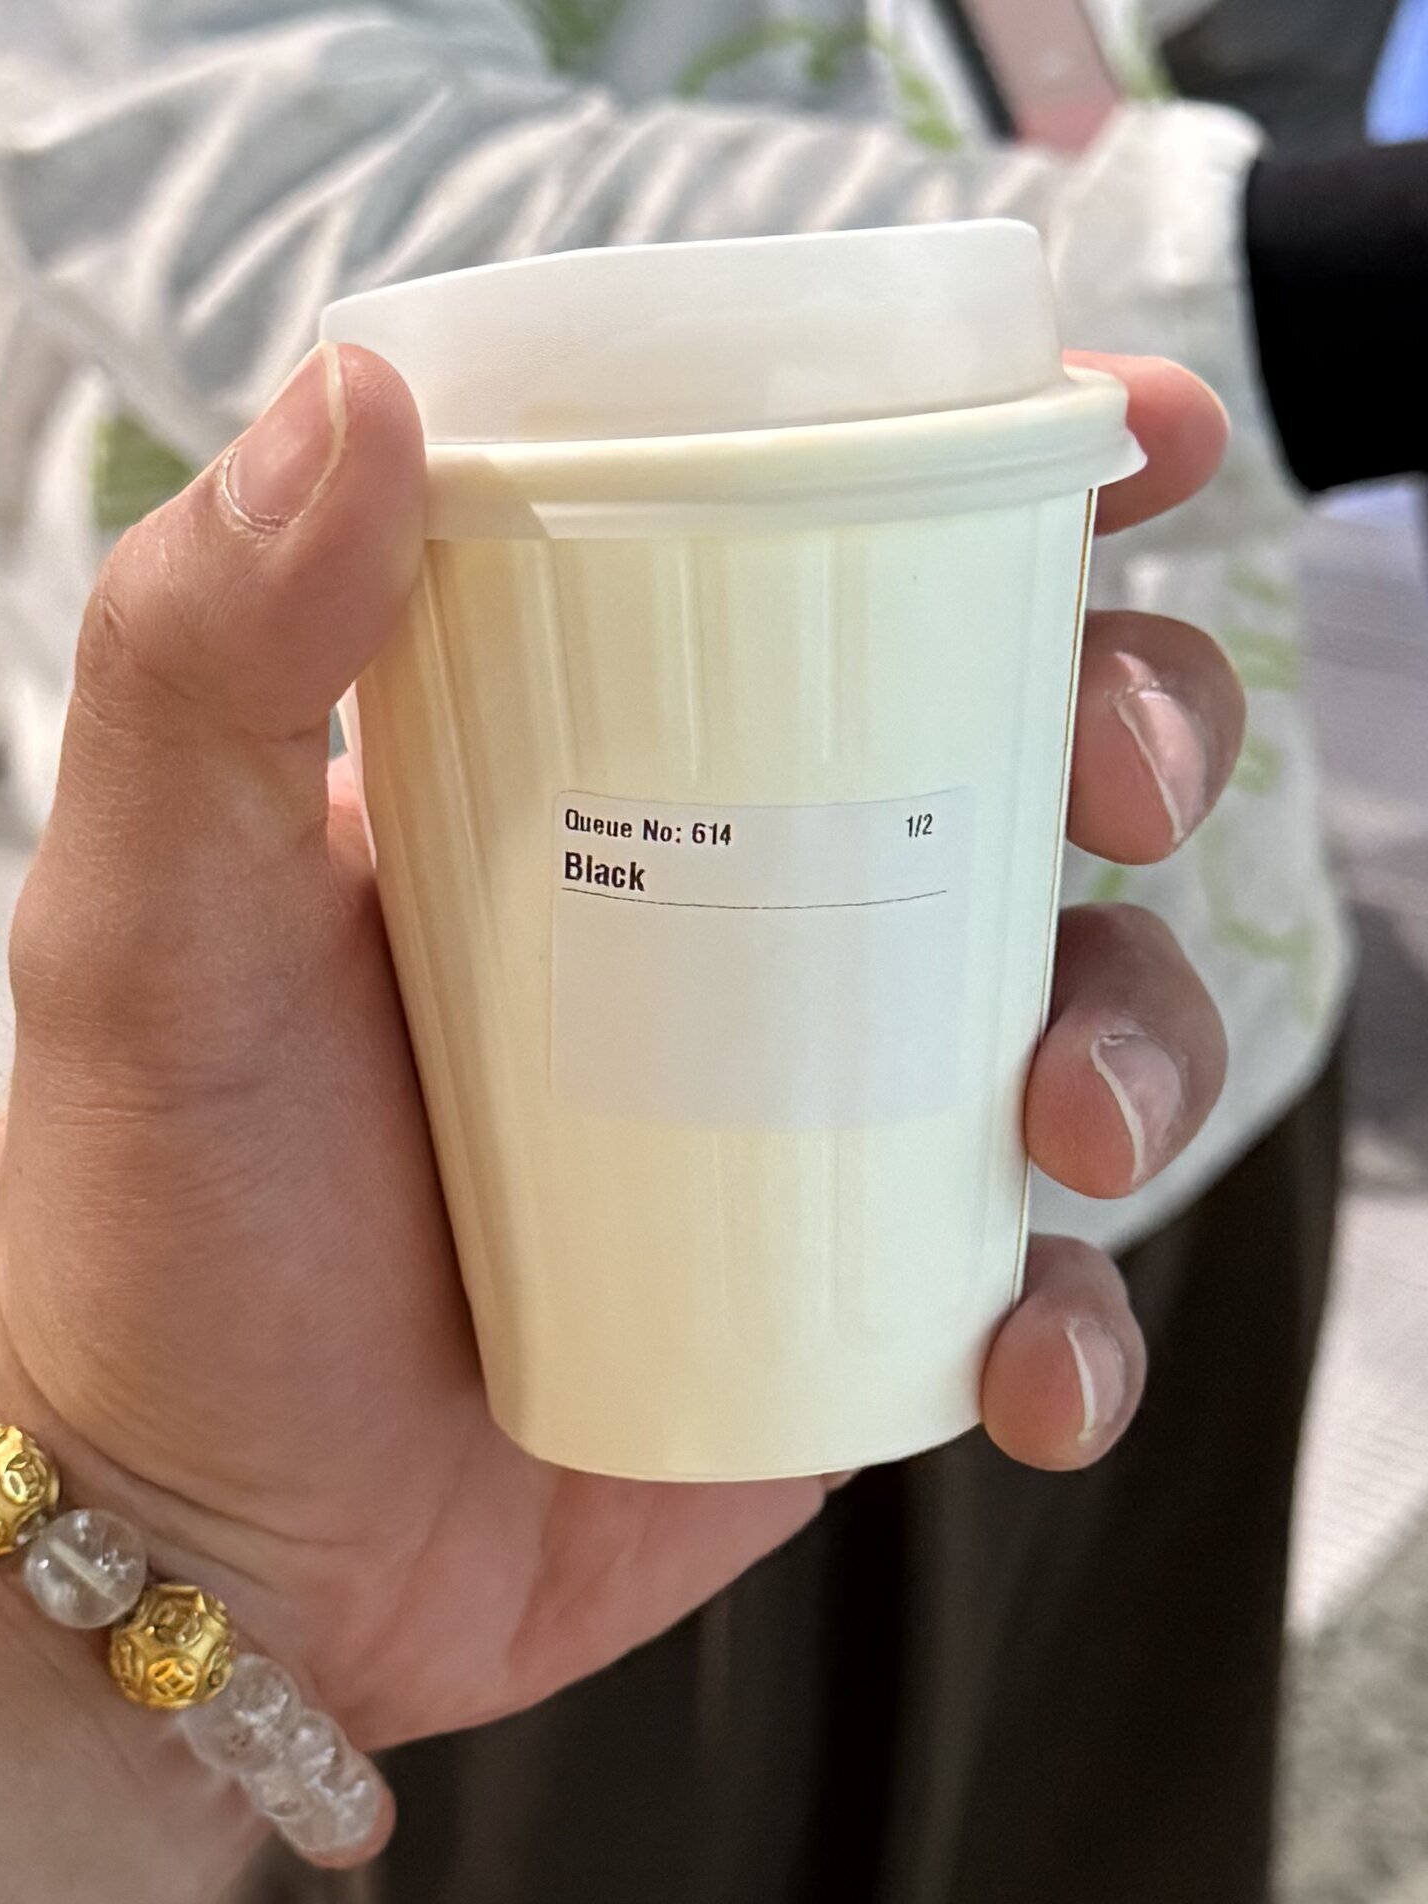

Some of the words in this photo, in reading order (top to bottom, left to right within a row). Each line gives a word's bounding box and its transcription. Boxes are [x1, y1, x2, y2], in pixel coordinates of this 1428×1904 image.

[564, 807, 634, 839] Queue
[642, 818, 683, 846] No:
[691, 821, 732, 847] 614
[905, 812, 934, 839] 1/2
[564, 850, 647, 893] Black
